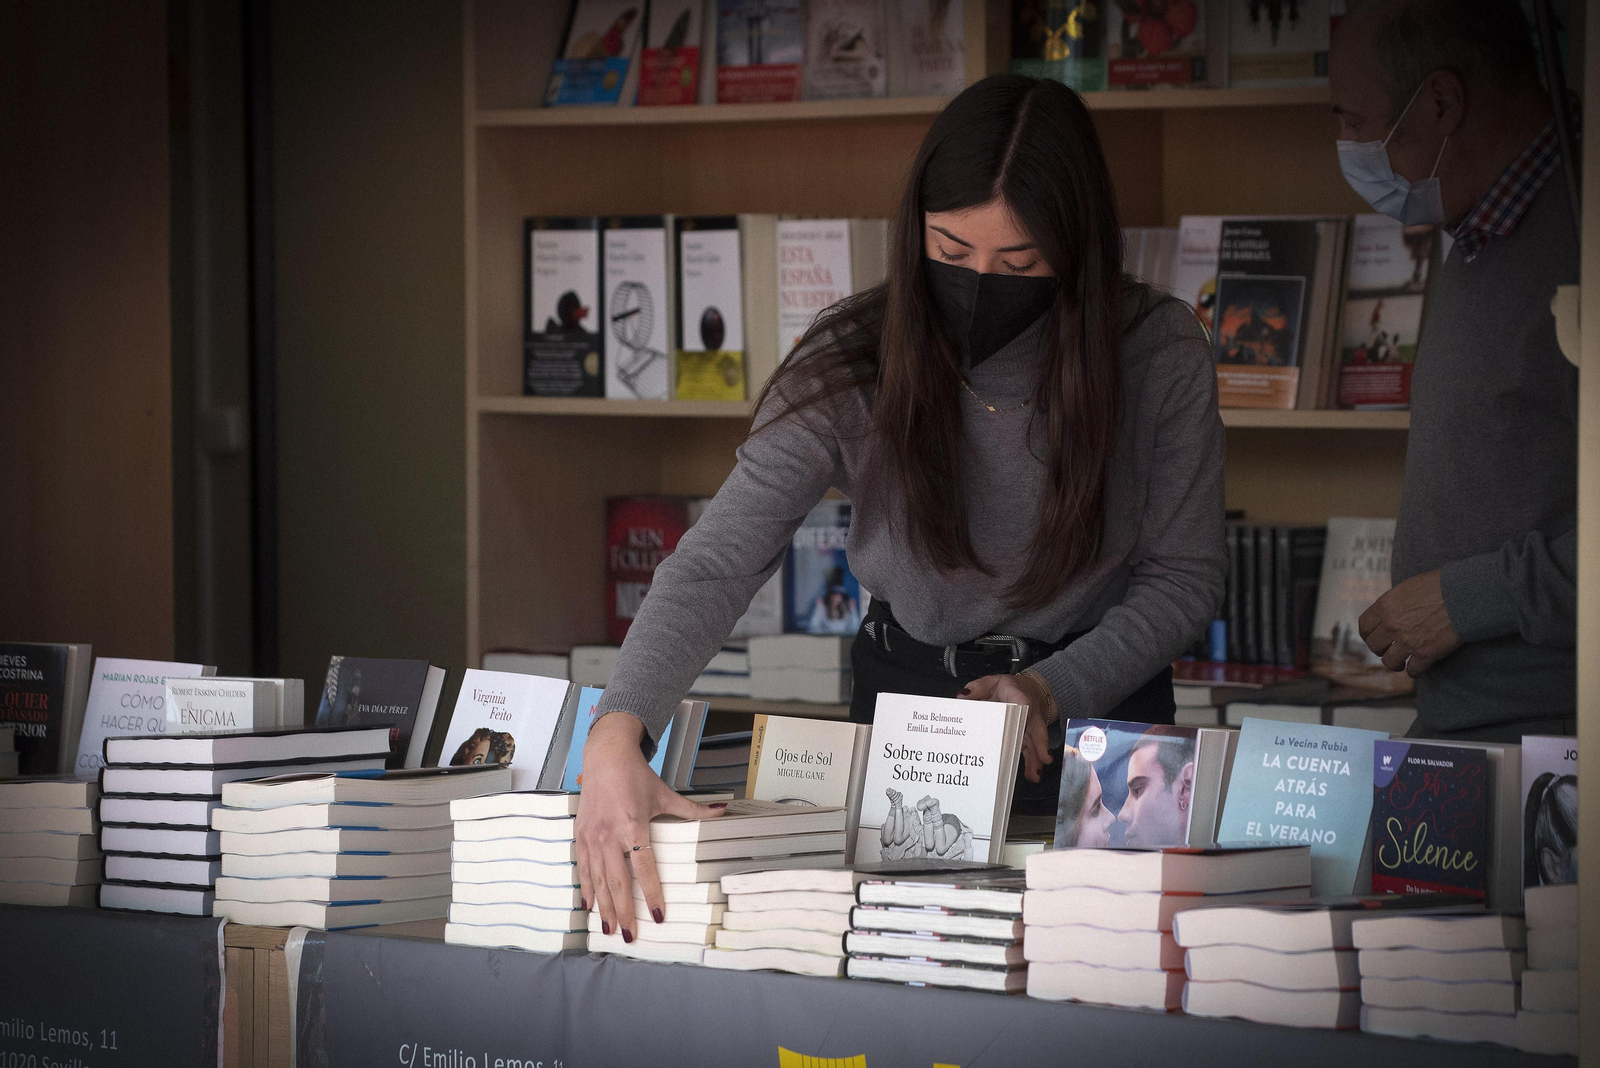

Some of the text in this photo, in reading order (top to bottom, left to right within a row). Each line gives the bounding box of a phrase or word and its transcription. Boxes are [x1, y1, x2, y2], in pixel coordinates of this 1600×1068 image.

[628, 527, 664, 548] KEN
[0, 655, 26, 667] IEVES
[102, 673, 131, 683] MARIAN
[134, 674, 159, 685] ROJAS
[0, 691, 48, 710] QUIER
[120, 690, 164, 710] CÓMO
[218, 688, 246, 698] CHILDERS
[472, 688, 507, 706] Virginia
[181, 709, 236, 726] ENIGMA
[358, 703, 409, 715] EVA DÍAZ PÉREZ
[489, 706, 513, 722] Feito
[912, 711, 963, 724] Rosa Belmonte
[101, 715, 166, 733] HACER QU
[906, 722, 967, 736] Emilia Landaluce
[1083, 735, 1104, 743] NETFLIX
[1274, 736, 1348, 752] La Vecina Rubia
[79, 754, 104, 768] COS
[775, 748, 833, 766] Ojos de Sol
[883, 742, 985, 767] Sobre nosotras
[1408, 757, 1420, 765] FLOR
[1427, 759, 1454, 768] SALVADOR
[1564, 750, 1578, 761] JO
[1262, 753, 1350, 776] LA CUENTA
[777, 767, 825, 780] MIGUEL GANE
[892, 764, 970, 787] Sobre nada
[1274, 775, 1328, 797] ATRÁS
[1274, 801, 1317, 819] PARA
[1246, 821, 1337, 845] EL VERANO
[1379, 816, 1478, 871] Silence
[0, 1018, 118, 1050] milio Lemos, 11
[0, 1051, 36, 1068] 1020
[399, 1043, 418, 1068] C/
[423, 1047, 476, 1068] Emilio
